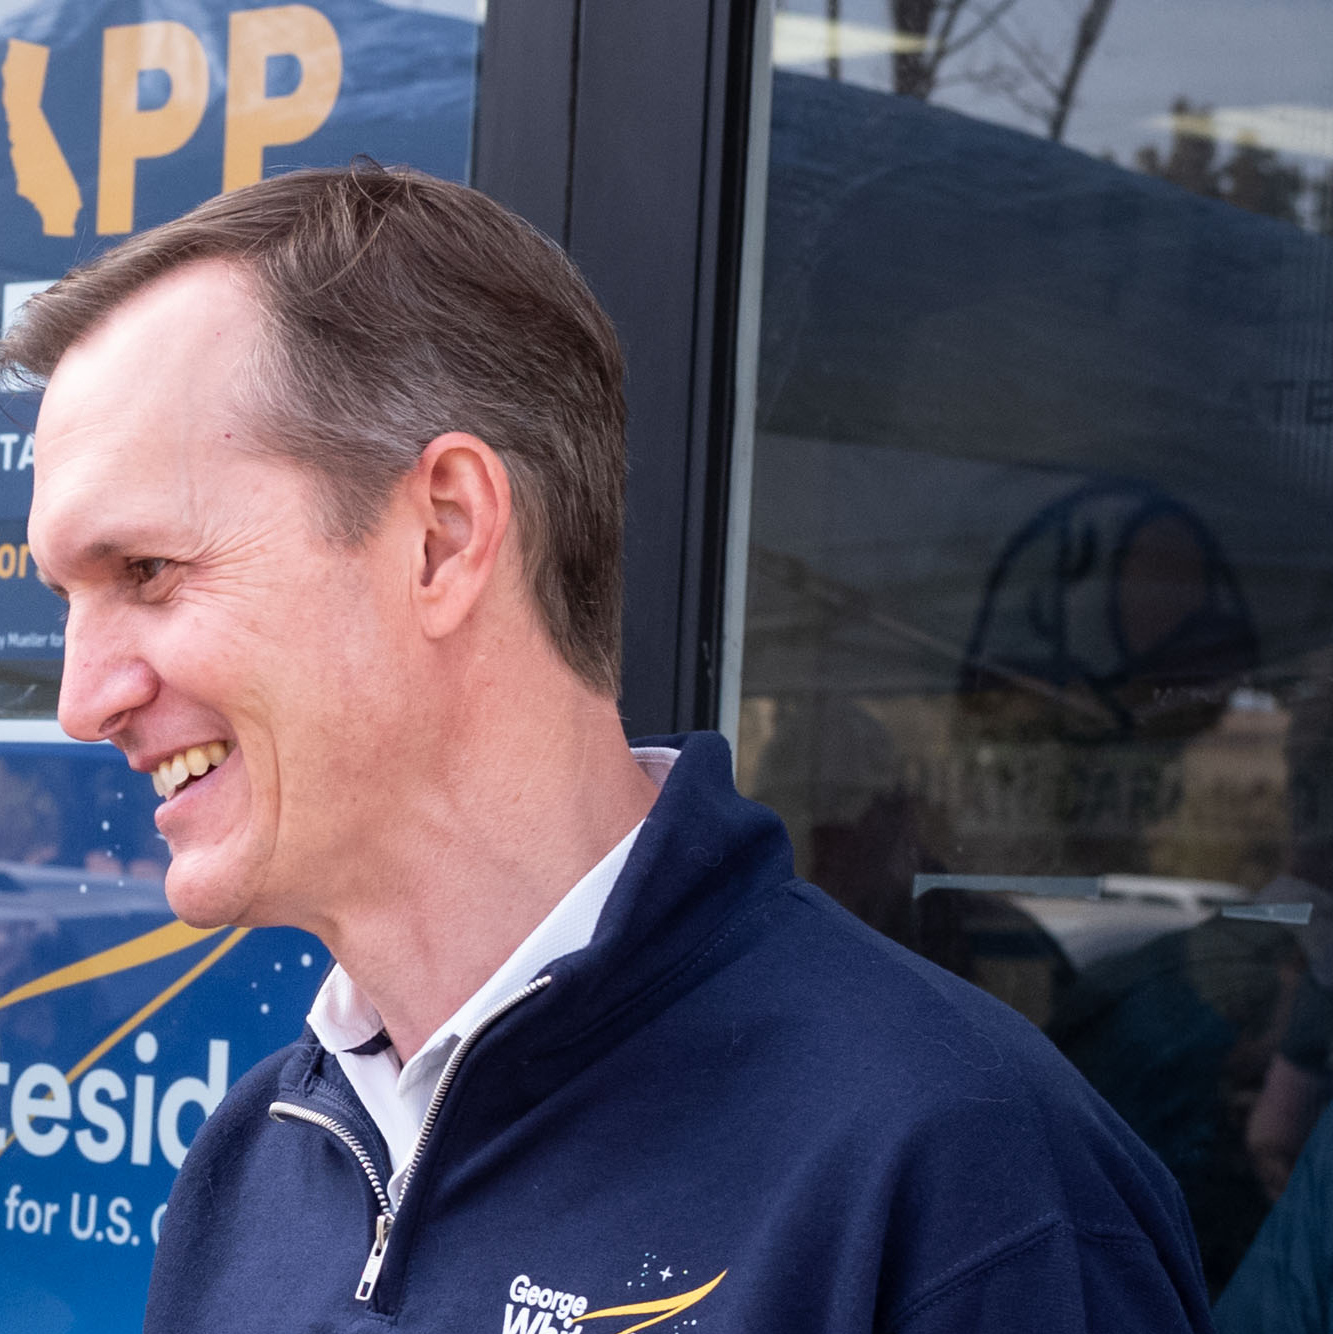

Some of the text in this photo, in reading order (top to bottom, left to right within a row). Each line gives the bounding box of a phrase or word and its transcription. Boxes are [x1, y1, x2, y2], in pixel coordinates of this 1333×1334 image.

[7, 631, 49, 648] Mueller
[5, 1184, 60, 1235] for
[70, 1192, 140, 1247] U.S.
[509, 1274, 588, 1319] George
